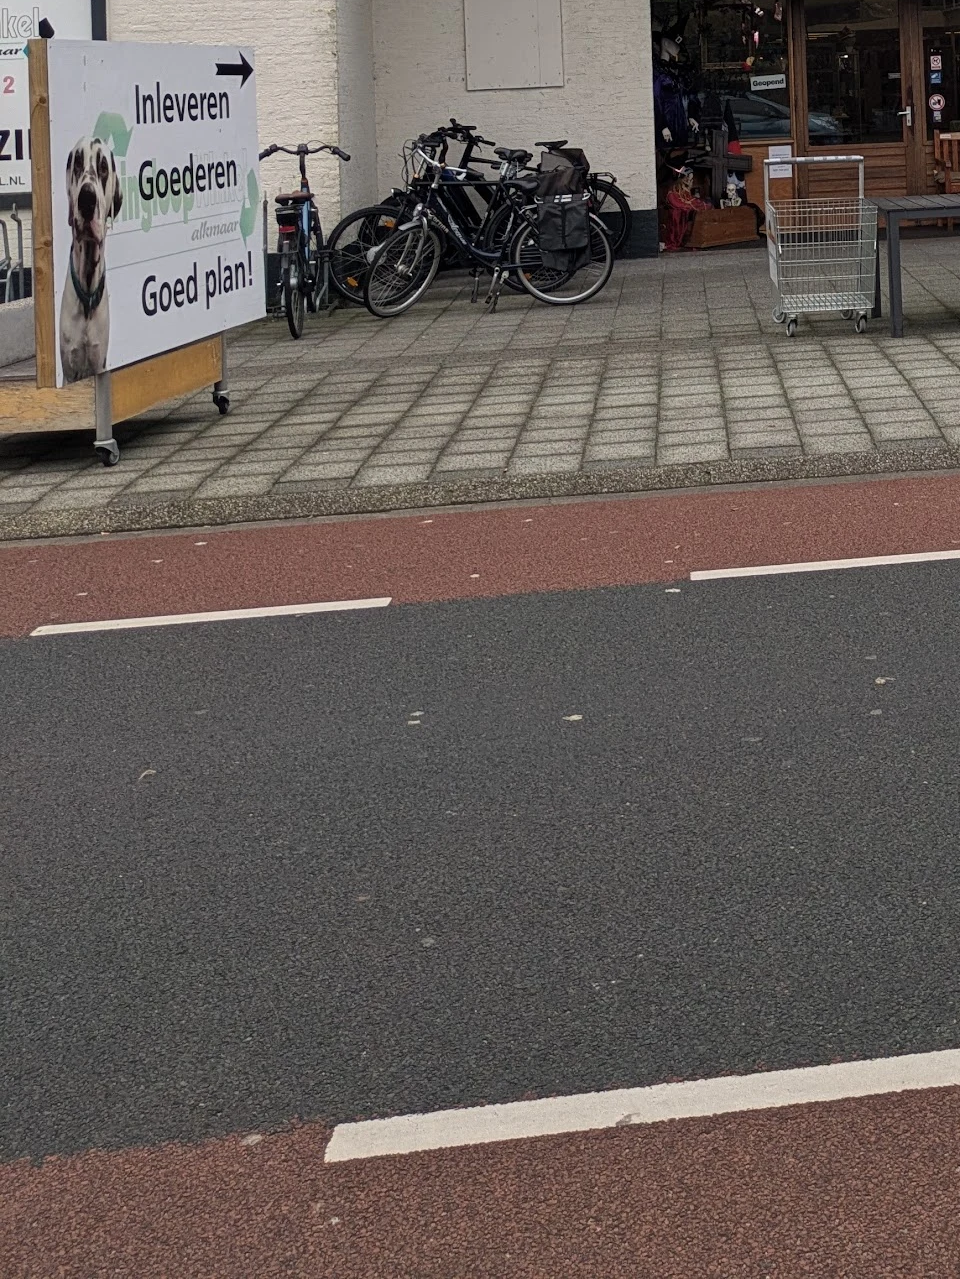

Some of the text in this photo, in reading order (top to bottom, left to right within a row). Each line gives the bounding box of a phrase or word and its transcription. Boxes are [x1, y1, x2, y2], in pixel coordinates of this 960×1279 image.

[0, 7, 39, 38] kel
[752, 77, 784, 87] Geopend
[135, 82, 230, 124] Inleveren
[0, 129, 31, 160] ZI
[138, 153, 237, 201] Goederen
[191, 220, 239, 241] alkmaar
[142, 250, 253, 316] Goed plan!
